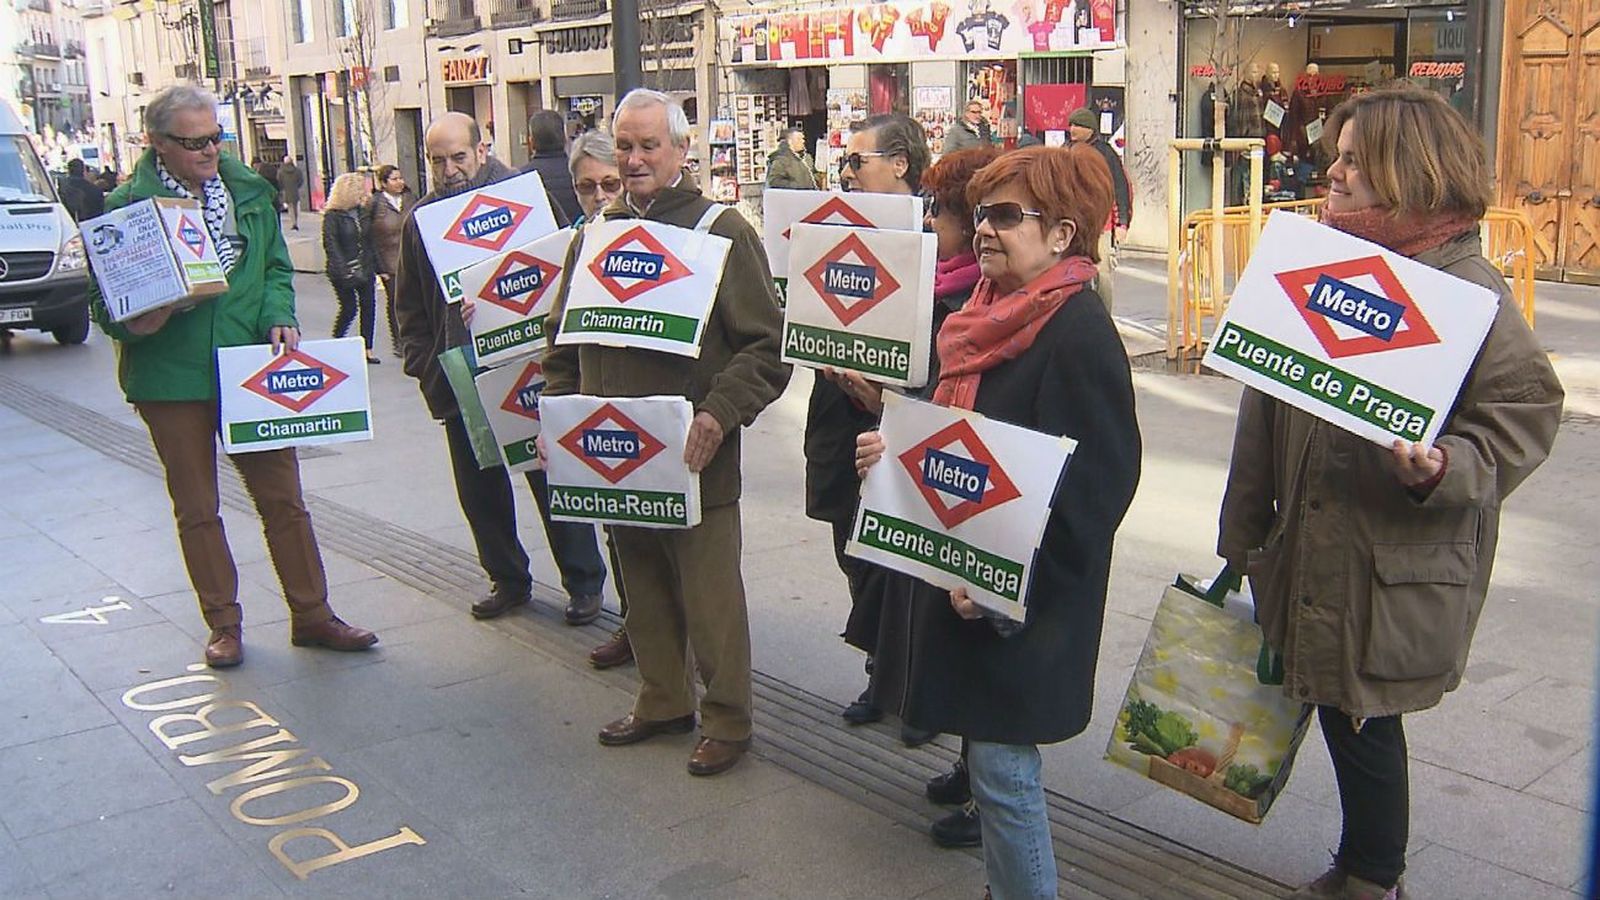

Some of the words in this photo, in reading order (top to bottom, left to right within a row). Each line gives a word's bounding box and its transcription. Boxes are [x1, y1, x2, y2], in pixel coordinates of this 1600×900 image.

[442, 57, 483, 81] FANZY
[1409, 62, 1465, 79] REBAJAS
[467, 214, 509, 236] Metro
[608, 255, 656, 276] Metro
[500, 275, 539, 297] Metro
[829, 268, 871, 291] Metro
[1317, 283, 1392, 331] Metro
[581, 310, 664, 334] Chamartin
[477, 329, 522, 353] Puente
[525, 322, 541, 337] de
[786, 328, 908, 372] Atocha-Renfe
[272, 373, 319, 389] Metro
[1219, 328, 1305, 382] Puente
[1311, 368, 1343, 398] de
[1347, 382, 1427, 436] Praga
[256, 416, 342, 438] Chamartin
[587, 435, 635, 454] Metro
[928, 457, 980, 493] Metro
[549, 489, 685, 519] Atocha-Renfe
[863, 516, 934, 556] Puente
[940, 541, 962, 566] de
[965, 550, 1019, 593] Praga
